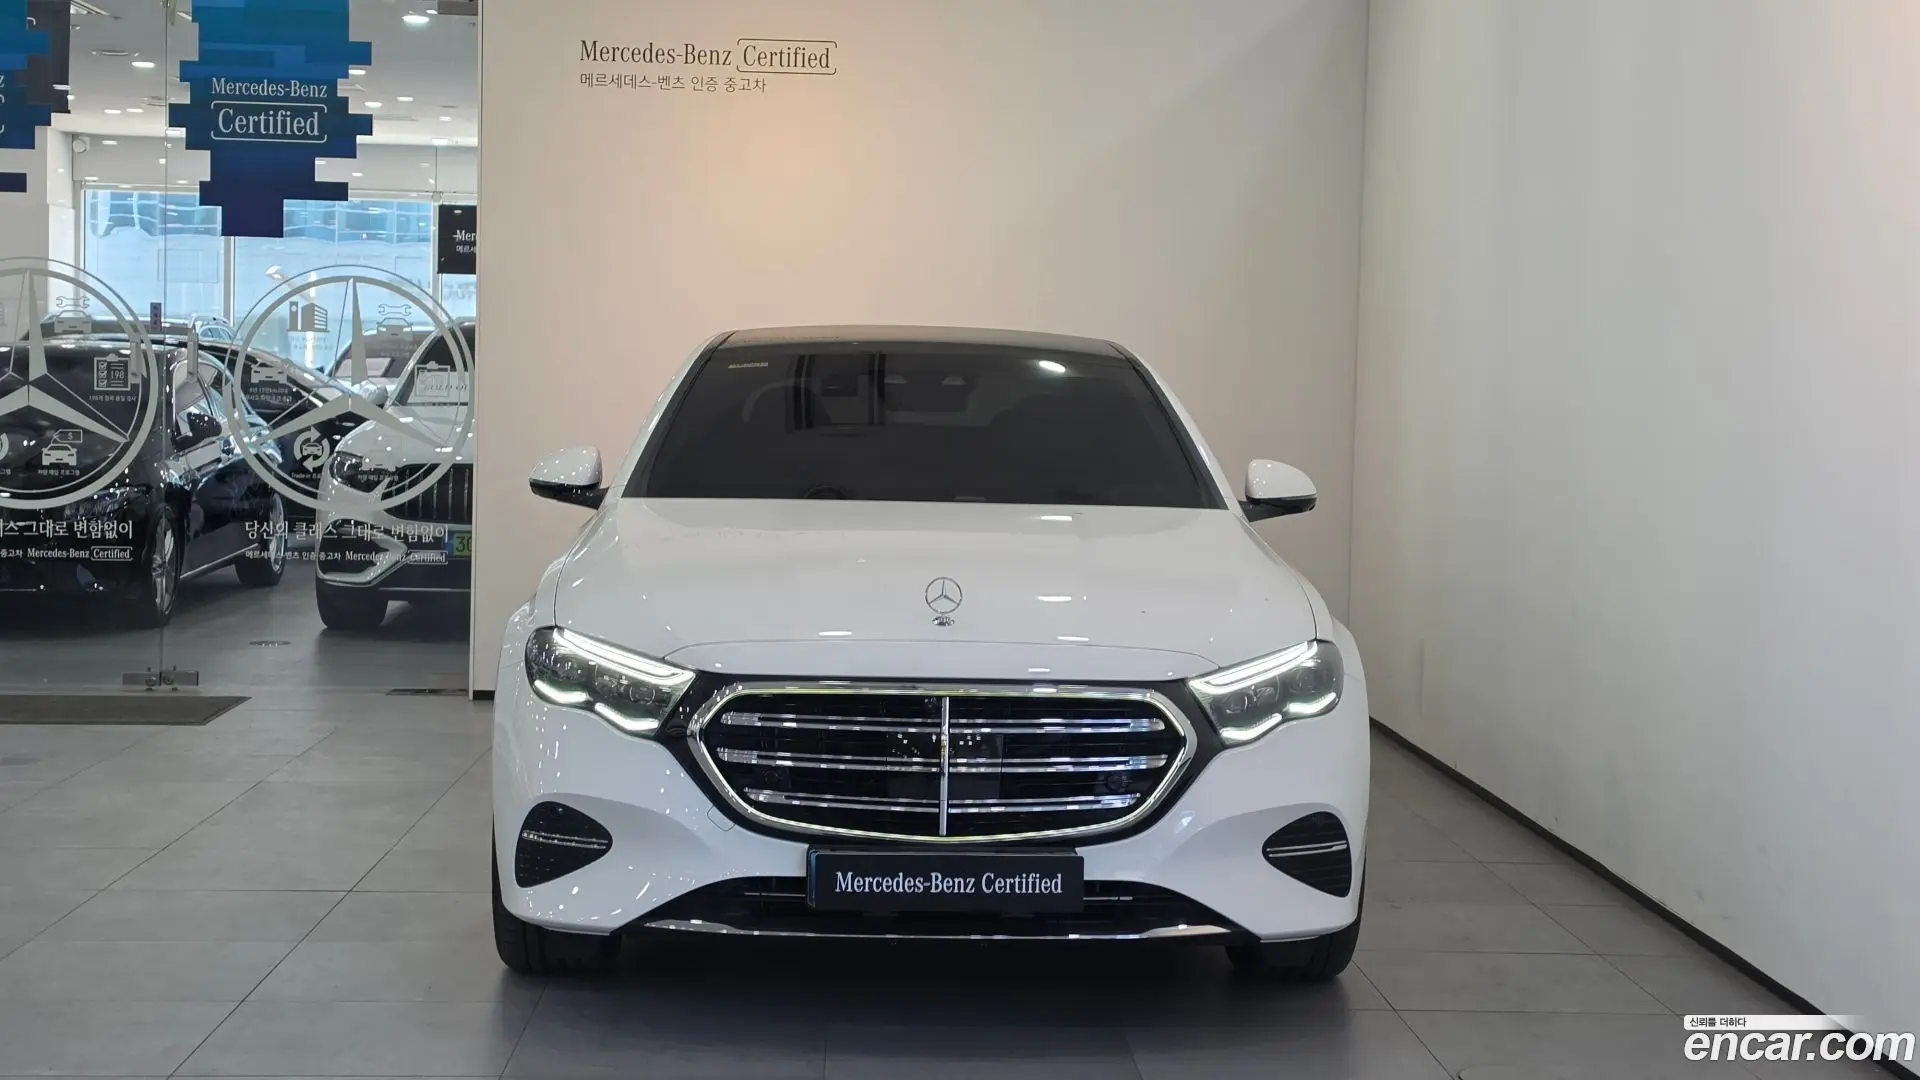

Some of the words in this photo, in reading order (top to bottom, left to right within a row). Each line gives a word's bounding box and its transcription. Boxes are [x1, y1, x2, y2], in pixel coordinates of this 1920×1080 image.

[580, 39, 732, 66] Mercedes-Benz
[742, 44, 830, 69] Certified
[211, 77, 328, 98] Mercedes-Benz
[580, 73, 685, 91] 메르세데스-벤츠
[690, 76, 719, 92] 인증
[723, 78, 767, 93] 중고차
[218, 108, 320, 136] Certified
[455, 229, 477, 241] Mer
[23, 519, 69, 538] 그대로
[74, 519, 133, 539] 변함없이
[245, 520, 288, 540] 당신의
[293, 521, 338, 540] 클래스
[391, 524, 449, 543] 변함없이
[27, 548, 90, 558] Mercedes-Benz
[93, 549, 130, 558] Certified
[835, 871, 975, 894] Mercedes-Benz
[981, 872, 1063, 894] Certified
